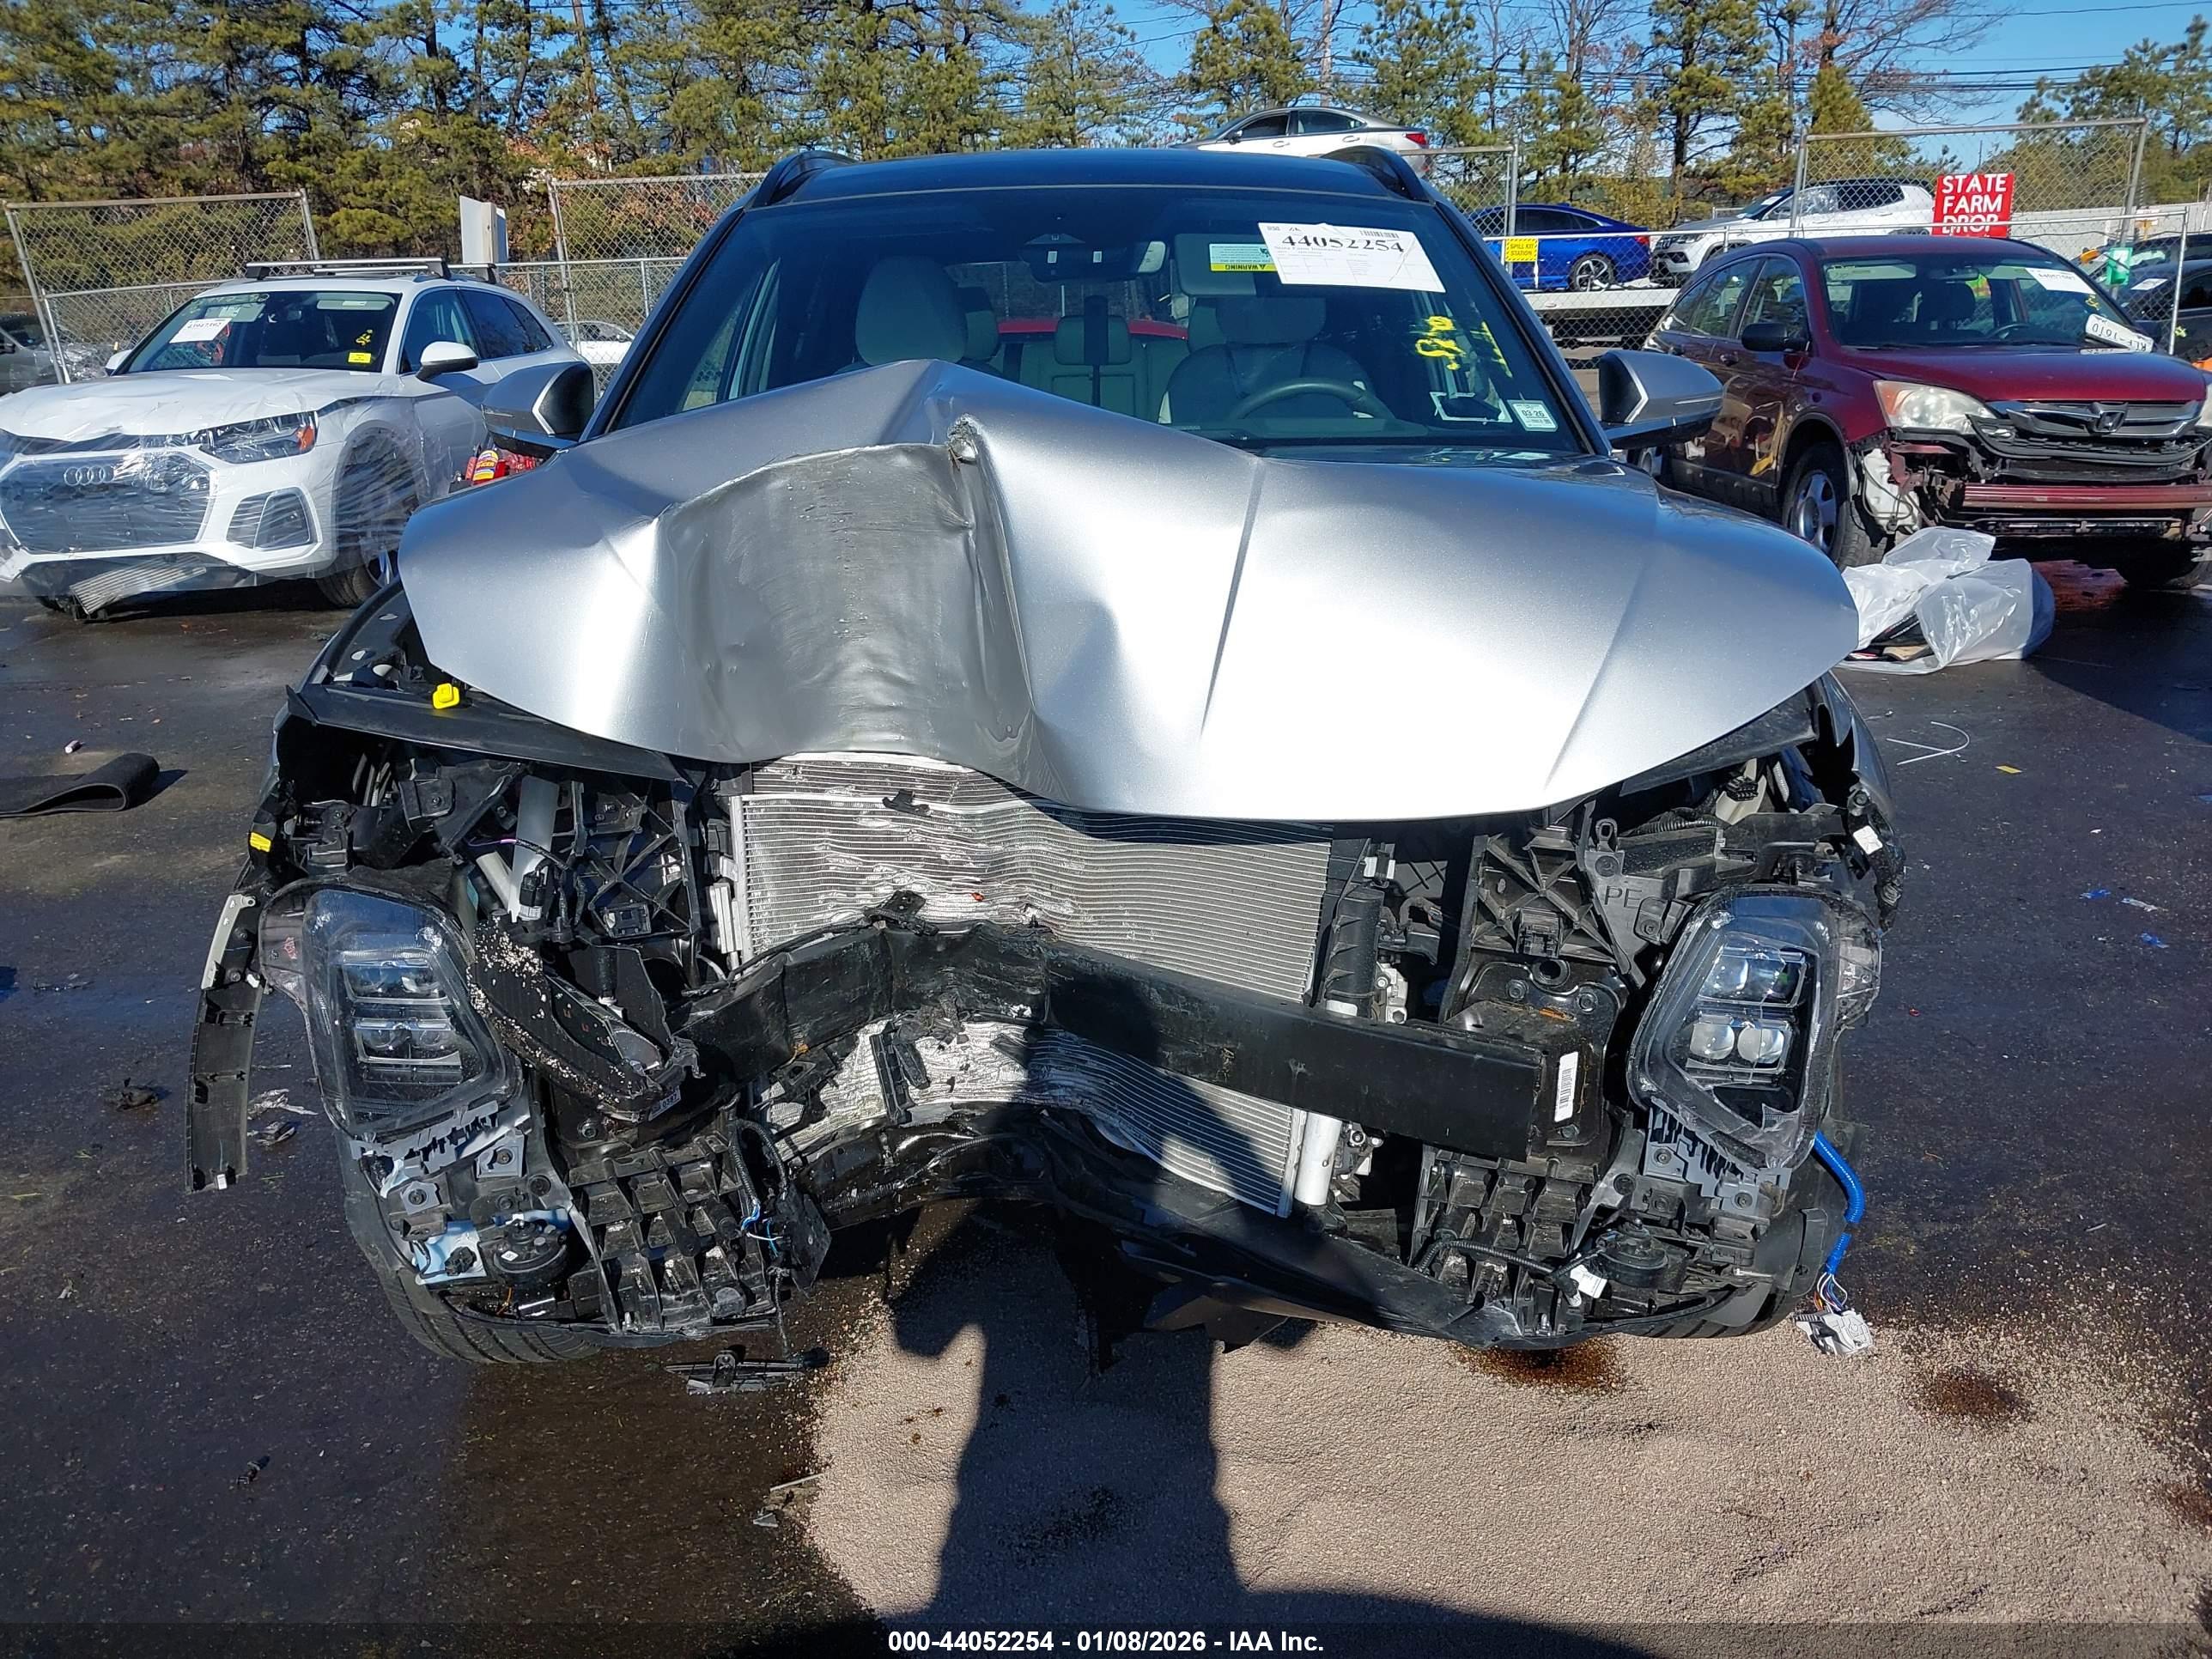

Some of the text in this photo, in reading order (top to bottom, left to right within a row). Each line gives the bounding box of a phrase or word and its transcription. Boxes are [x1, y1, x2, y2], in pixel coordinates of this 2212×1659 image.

[1942, 173, 2008, 194] STATE
[1942, 193, 2003, 215] FARM
[1942, 213, 1999, 234] DROP
[1282, 234, 1405, 253] 44052254
[1604, 885, 1643, 908] PE
